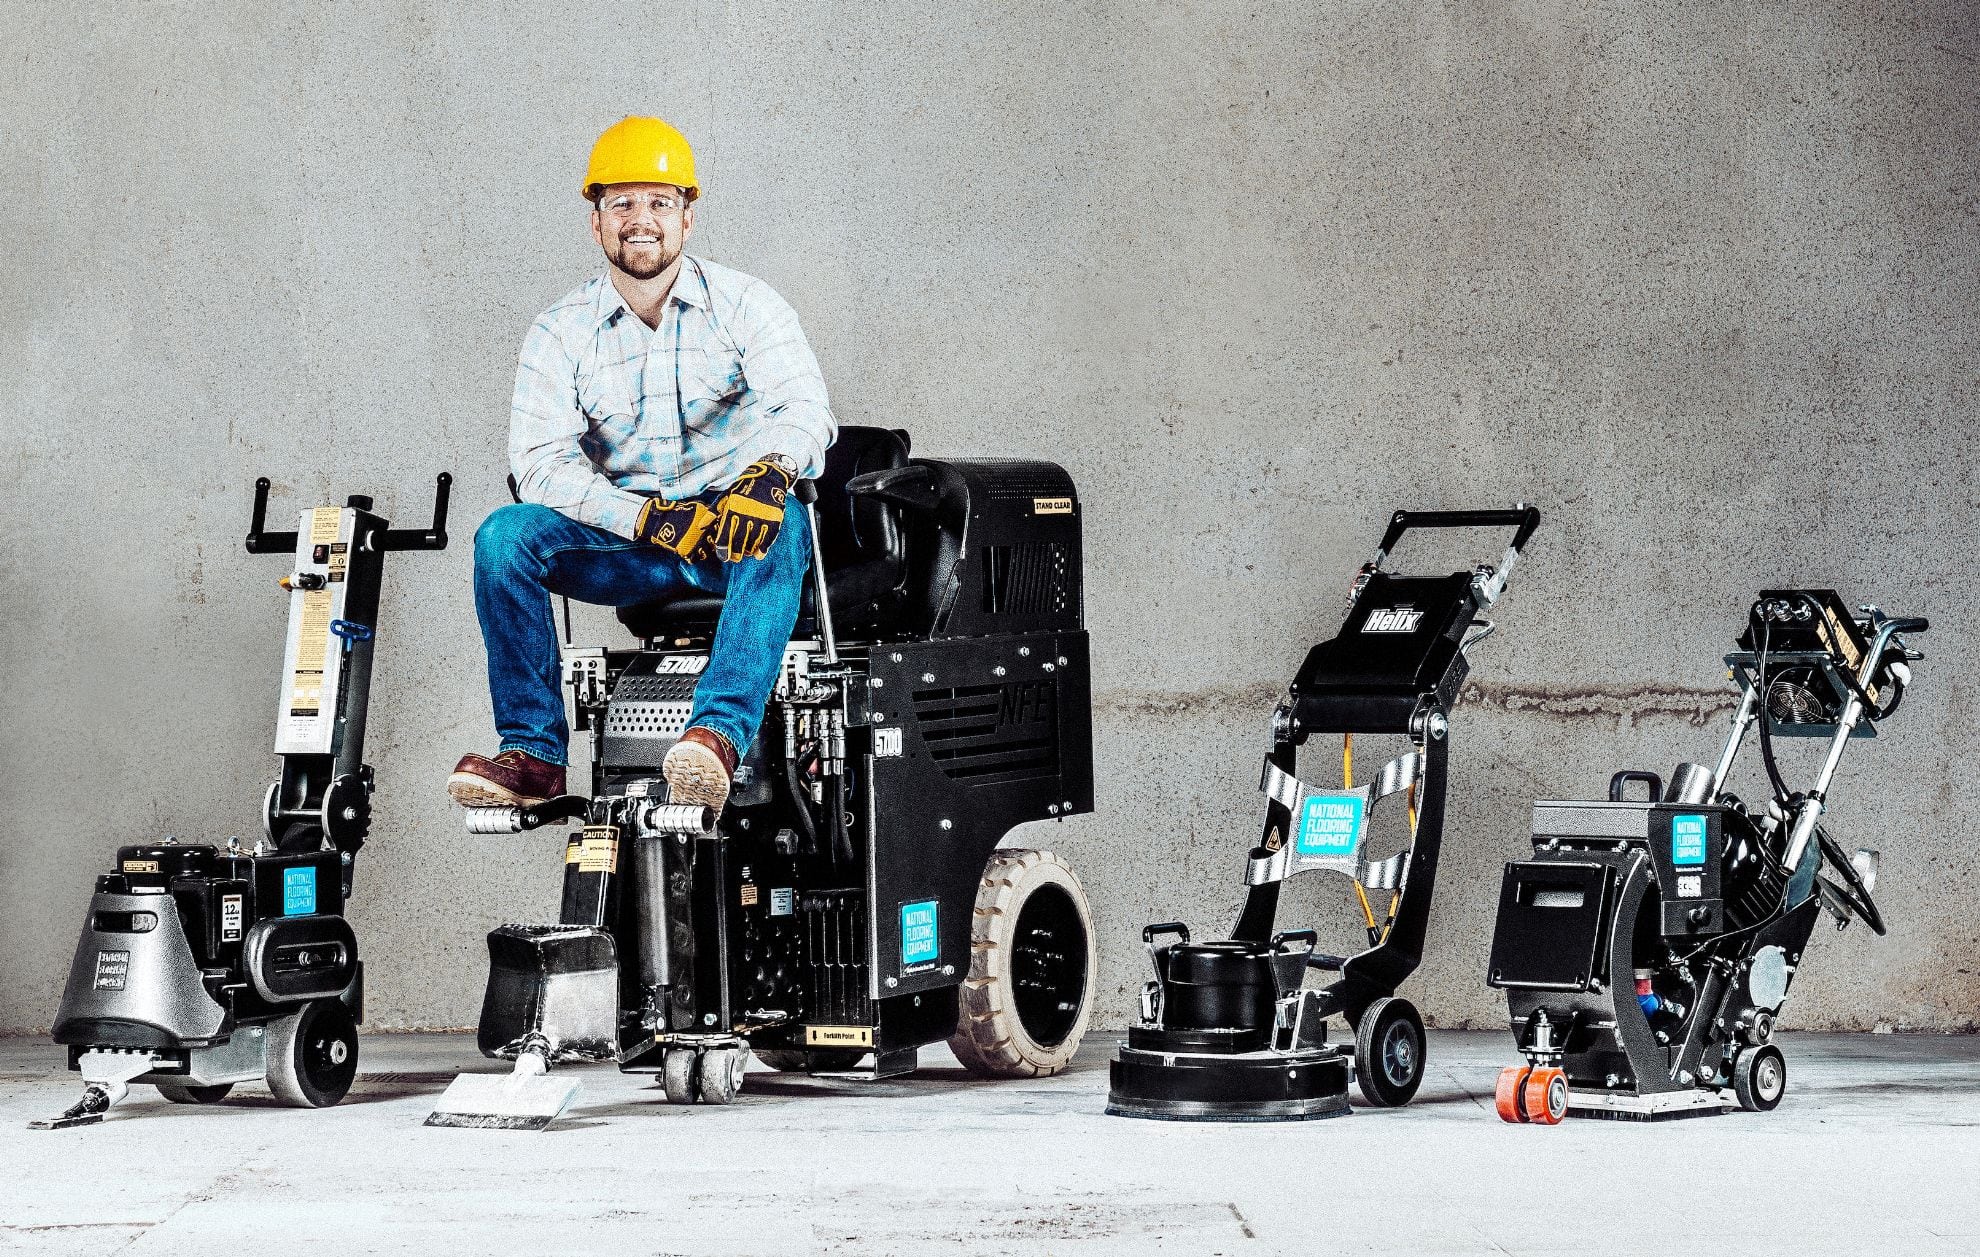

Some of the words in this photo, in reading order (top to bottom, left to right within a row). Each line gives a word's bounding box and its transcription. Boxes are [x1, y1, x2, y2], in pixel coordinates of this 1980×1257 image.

[1036, 502, 1053, 510] STAND
[1054, 501, 1071, 509] CLEAR
[1363, 609, 1422, 631] Helix
[656, 655, 709, 674] 5700
[875, 727, 903, 758] 5700
[1309, 803, 1354, 818] NATIONAL
[1306, 818, 1353, 832] FLOORING
[582, 831, 614, 839] CAUTION
[1304, 833, 1351, 847] EQUIPMENT
[287, 873, 312, 885] NATIONAL
[287, 885, 312, 898] FLOORING
[906, 910, 933, 926] NATIONAL
[907, 923, 934, 941] FLOORING
[907, 939, 933, 955] EQUIPMENT
[824, 1032, 841, 1040] Forklift
